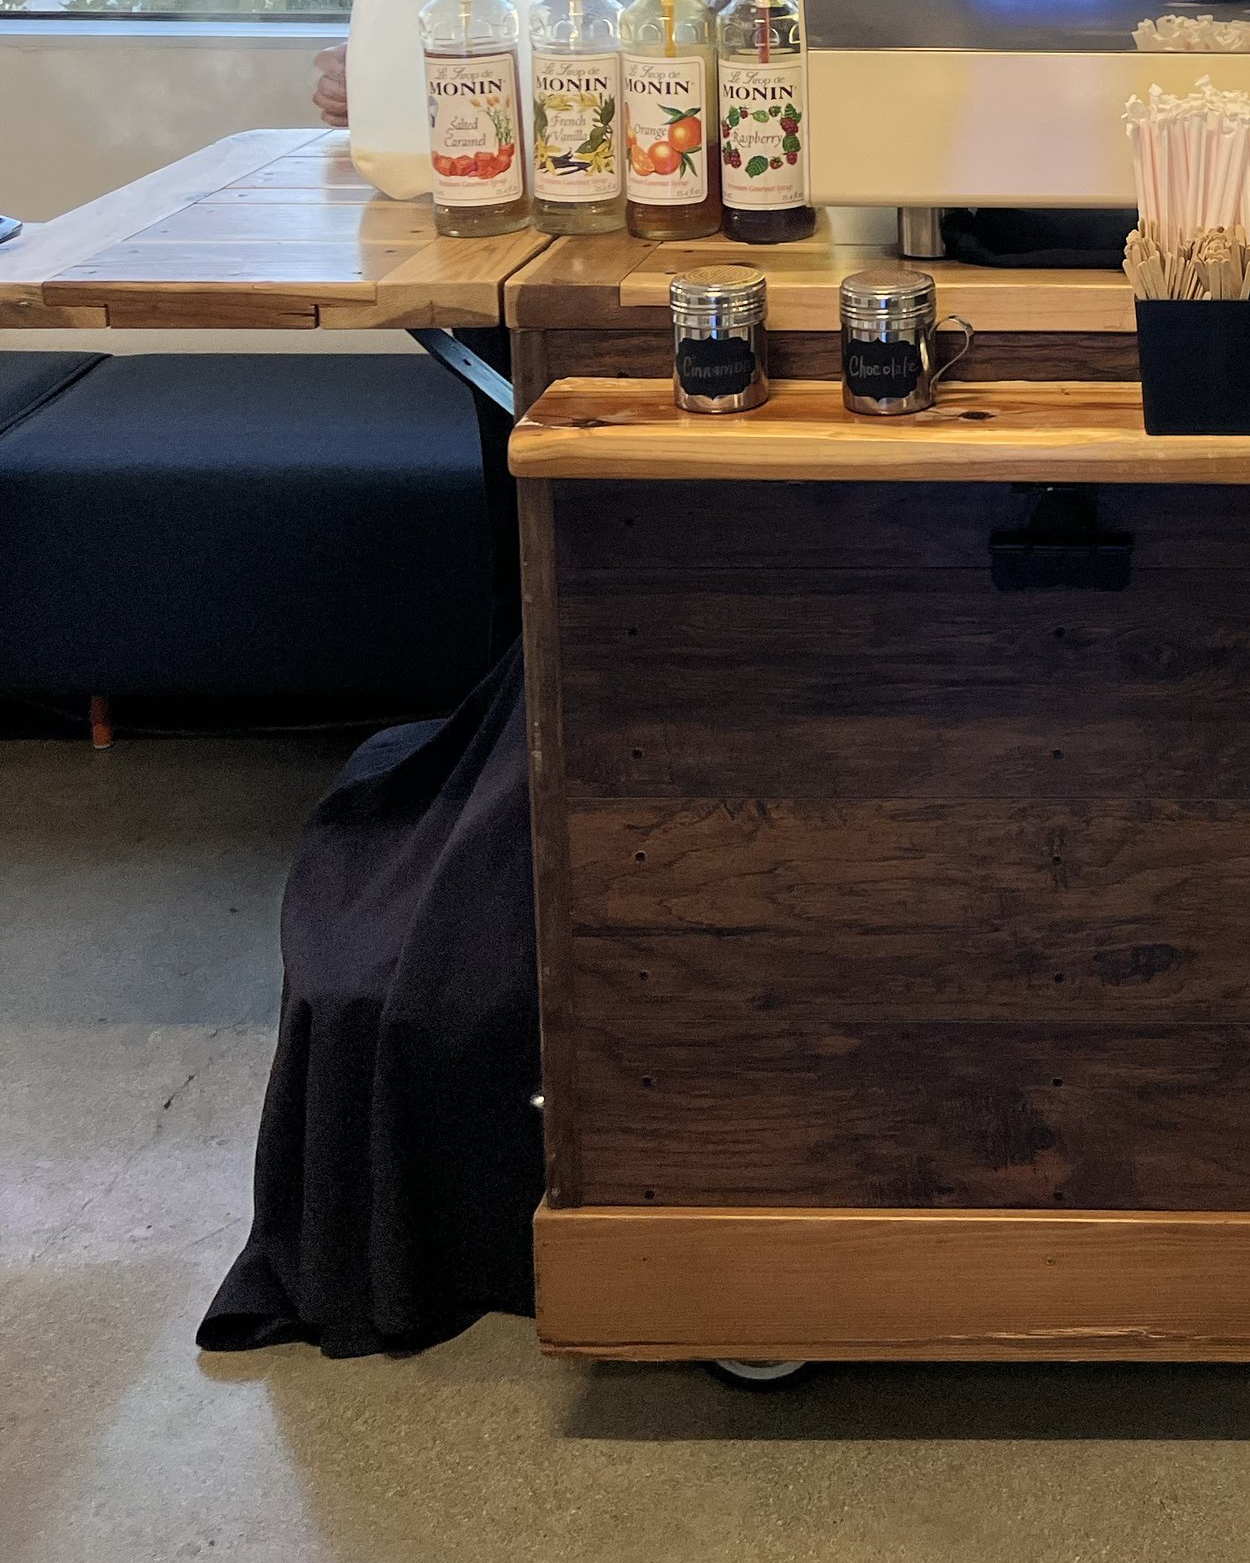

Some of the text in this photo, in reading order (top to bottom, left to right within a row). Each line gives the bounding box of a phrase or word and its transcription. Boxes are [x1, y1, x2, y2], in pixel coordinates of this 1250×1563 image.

[430, 79, 503, 96] MONIN
[536, 76, 608, 92] MONIN
[723, 84, 794, 101] MONIN
[446, 116, 479, 137] Salted
[549, 113, 586, 128] French
[444, 133, 487, 148] Caramel
[549, 128, 588, 142] Vanilla
[634, 123, 667, 141] Orange
[732, 130, 784, 149] Raspberry
